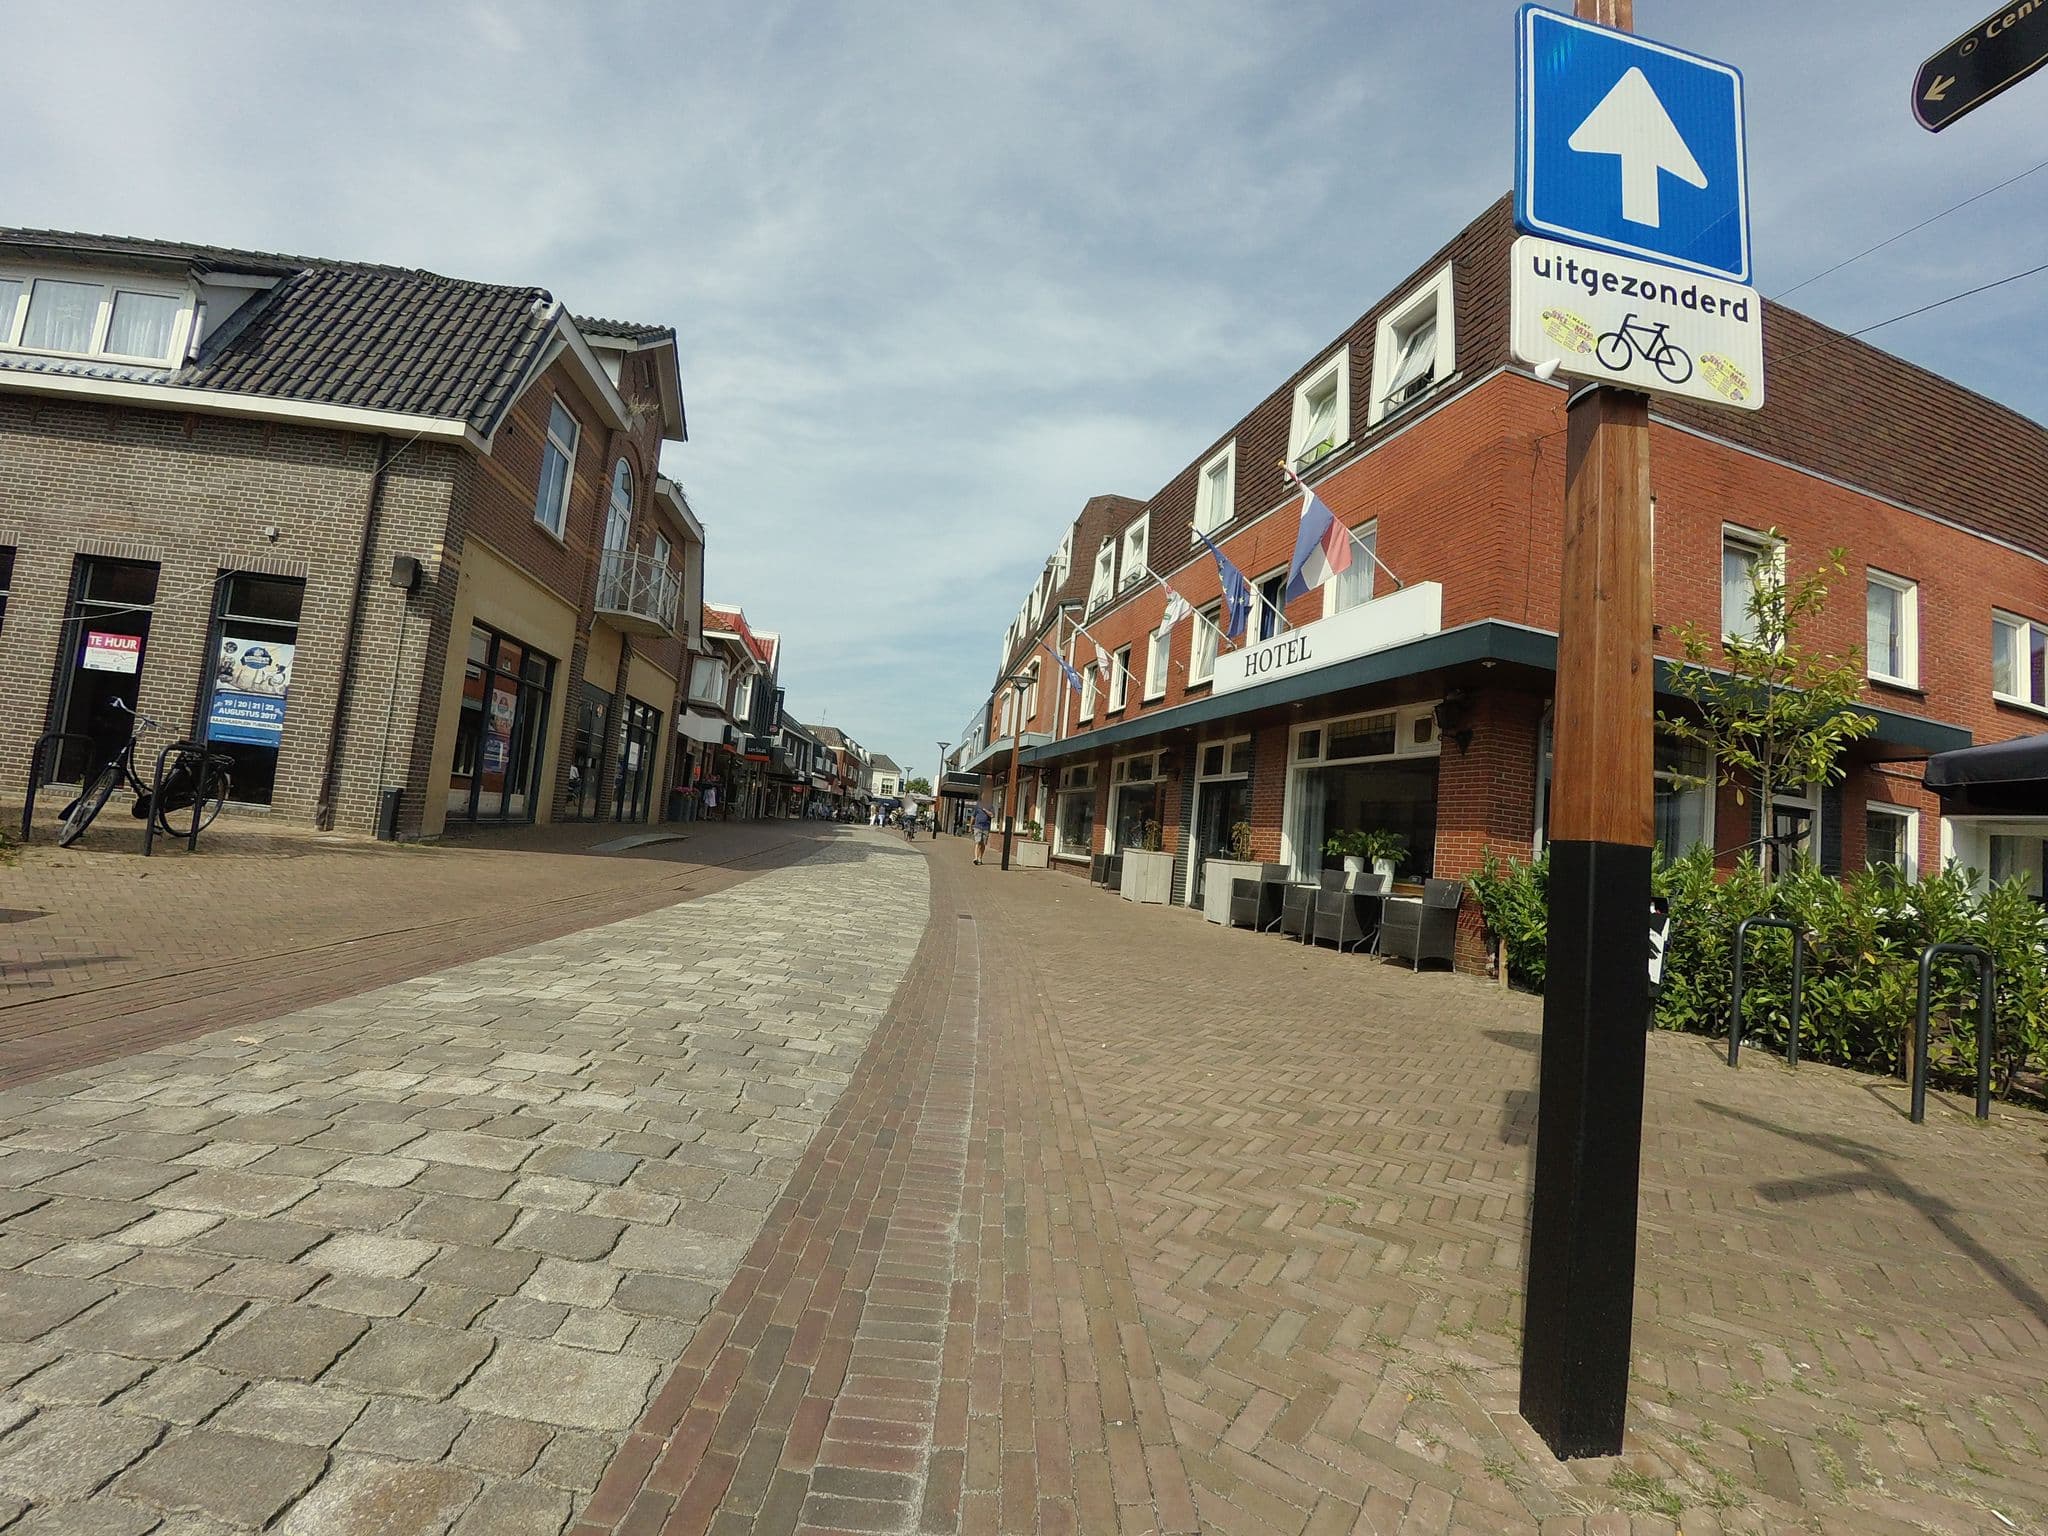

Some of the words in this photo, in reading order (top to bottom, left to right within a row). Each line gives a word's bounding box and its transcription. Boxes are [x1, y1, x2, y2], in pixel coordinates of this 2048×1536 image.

[1986, 0, 2047, 38] Cent
[1533, 255, 1748, 322] uitgezonderd
[89, 635, 102, 646] TE
[104, 637, 137, 649] HUUR
[1244, 635, 1313, 677] HOTEL
[218, 708, 260, 718] AUGUSTUS
[260, 712, 278, 720] 2017
